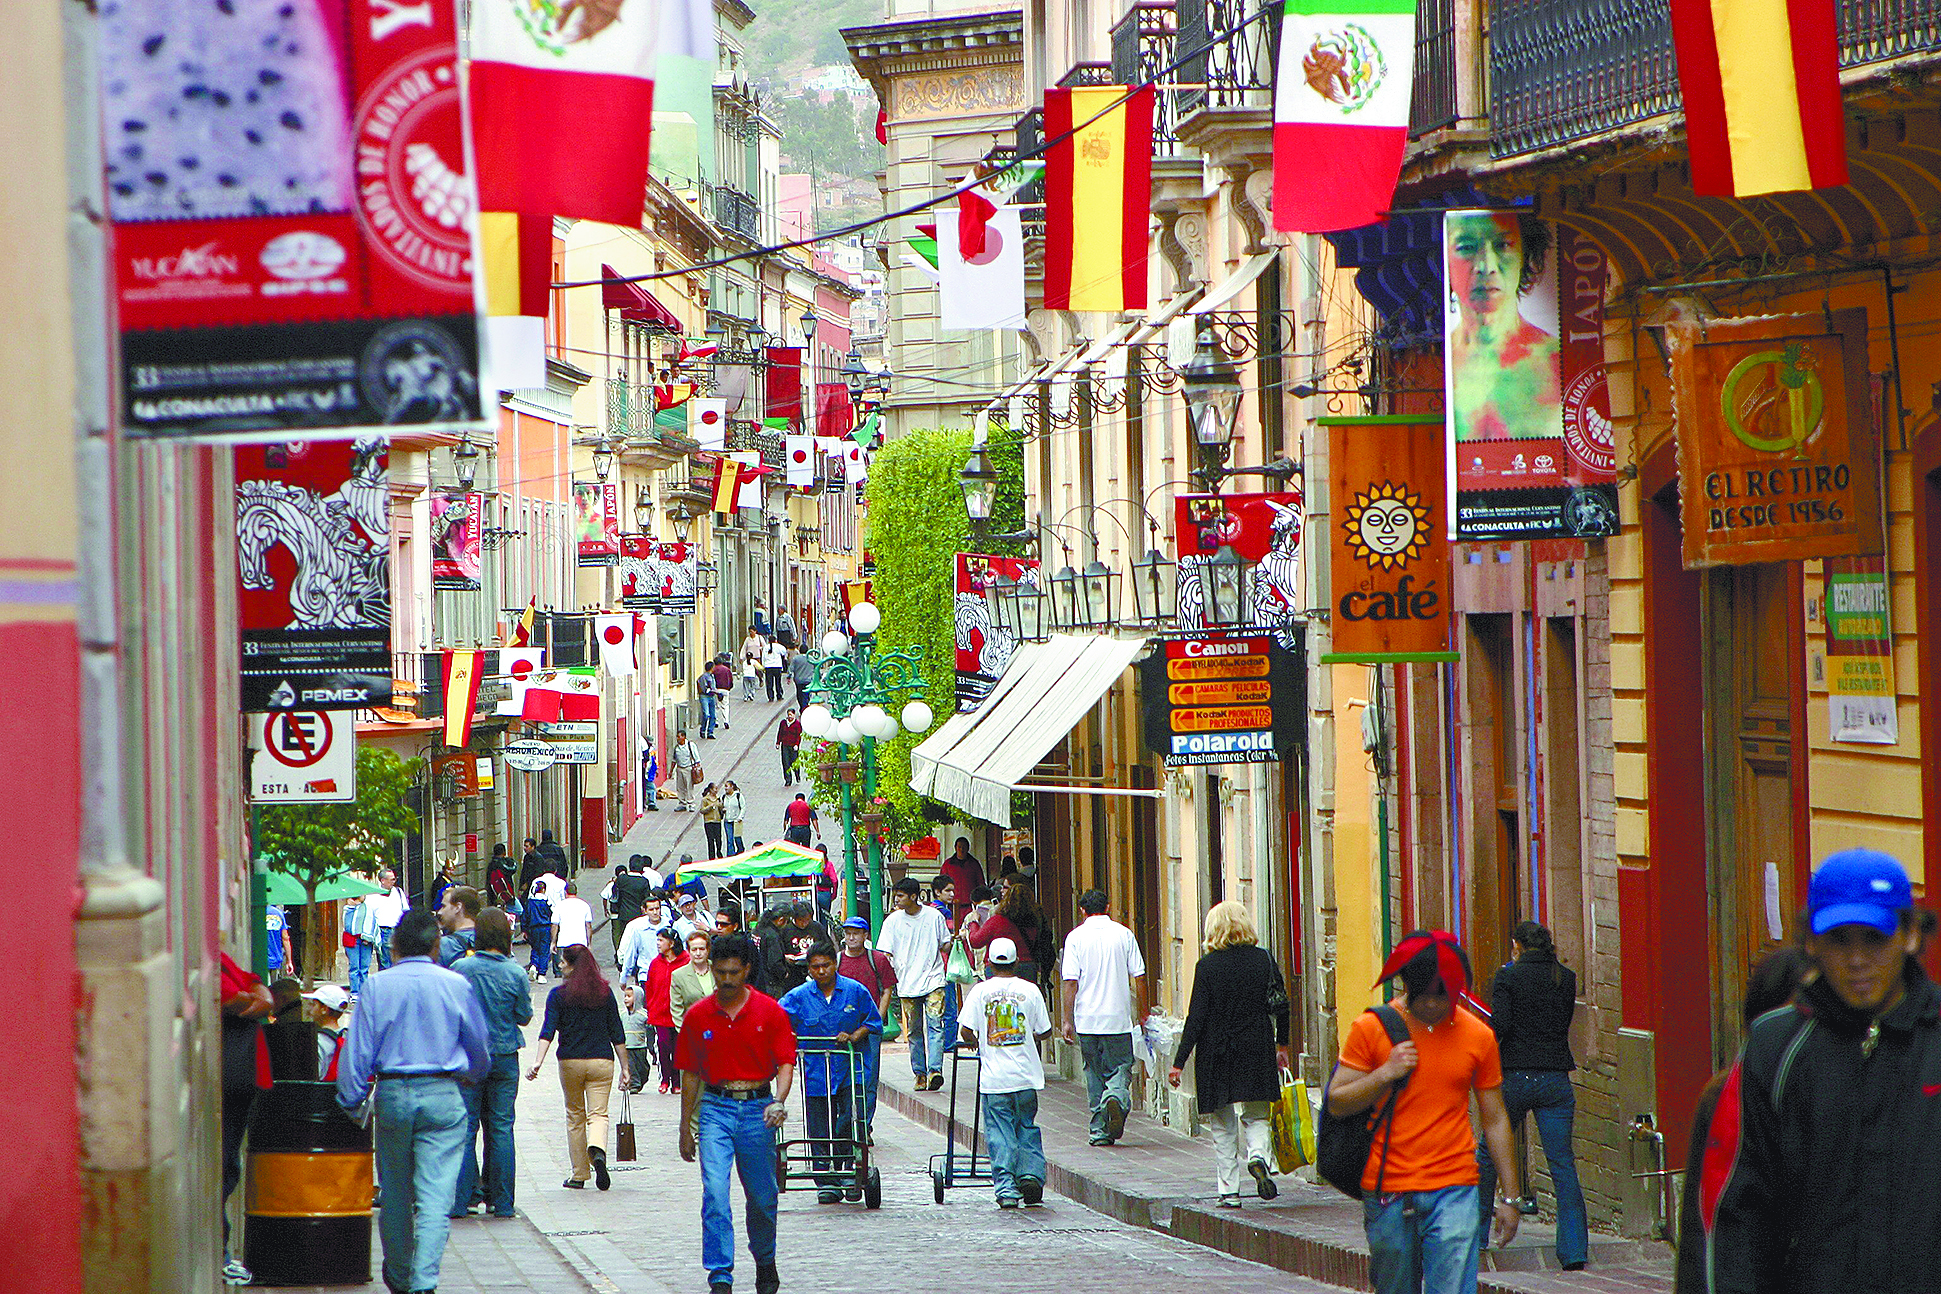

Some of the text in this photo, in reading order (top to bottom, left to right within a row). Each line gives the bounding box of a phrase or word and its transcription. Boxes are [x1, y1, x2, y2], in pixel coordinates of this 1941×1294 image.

[364, 69, 435, 140] HONOR
[358, 144, 386, 175] DE
[1565, 372, 1608, 467] INVITADOS DE HONOR
[1704, 464, 1851, 500] EL RETIRO
[1460, 507, 1473, 519] 33
[1708, 499, 1844, 530] DESDE 1956
[1472, 521, 1525, 532] CONACULTA
[1360, 574, 1375, 591] el
[1339, 575, 1440, 621] café
[243, 641, 260, 656] 33
[1184, 640, 1249, 657] Canon
[301, 688, 369, 702] PEMEX
[1194, 681, 1269, 693] CAMARAS PELICULAS
[1209, 716, 1270, 728] PROFESIONALES
[1172, 730, 1274, 754] Polaroid
[262, 783, 289, 794] ESTA
